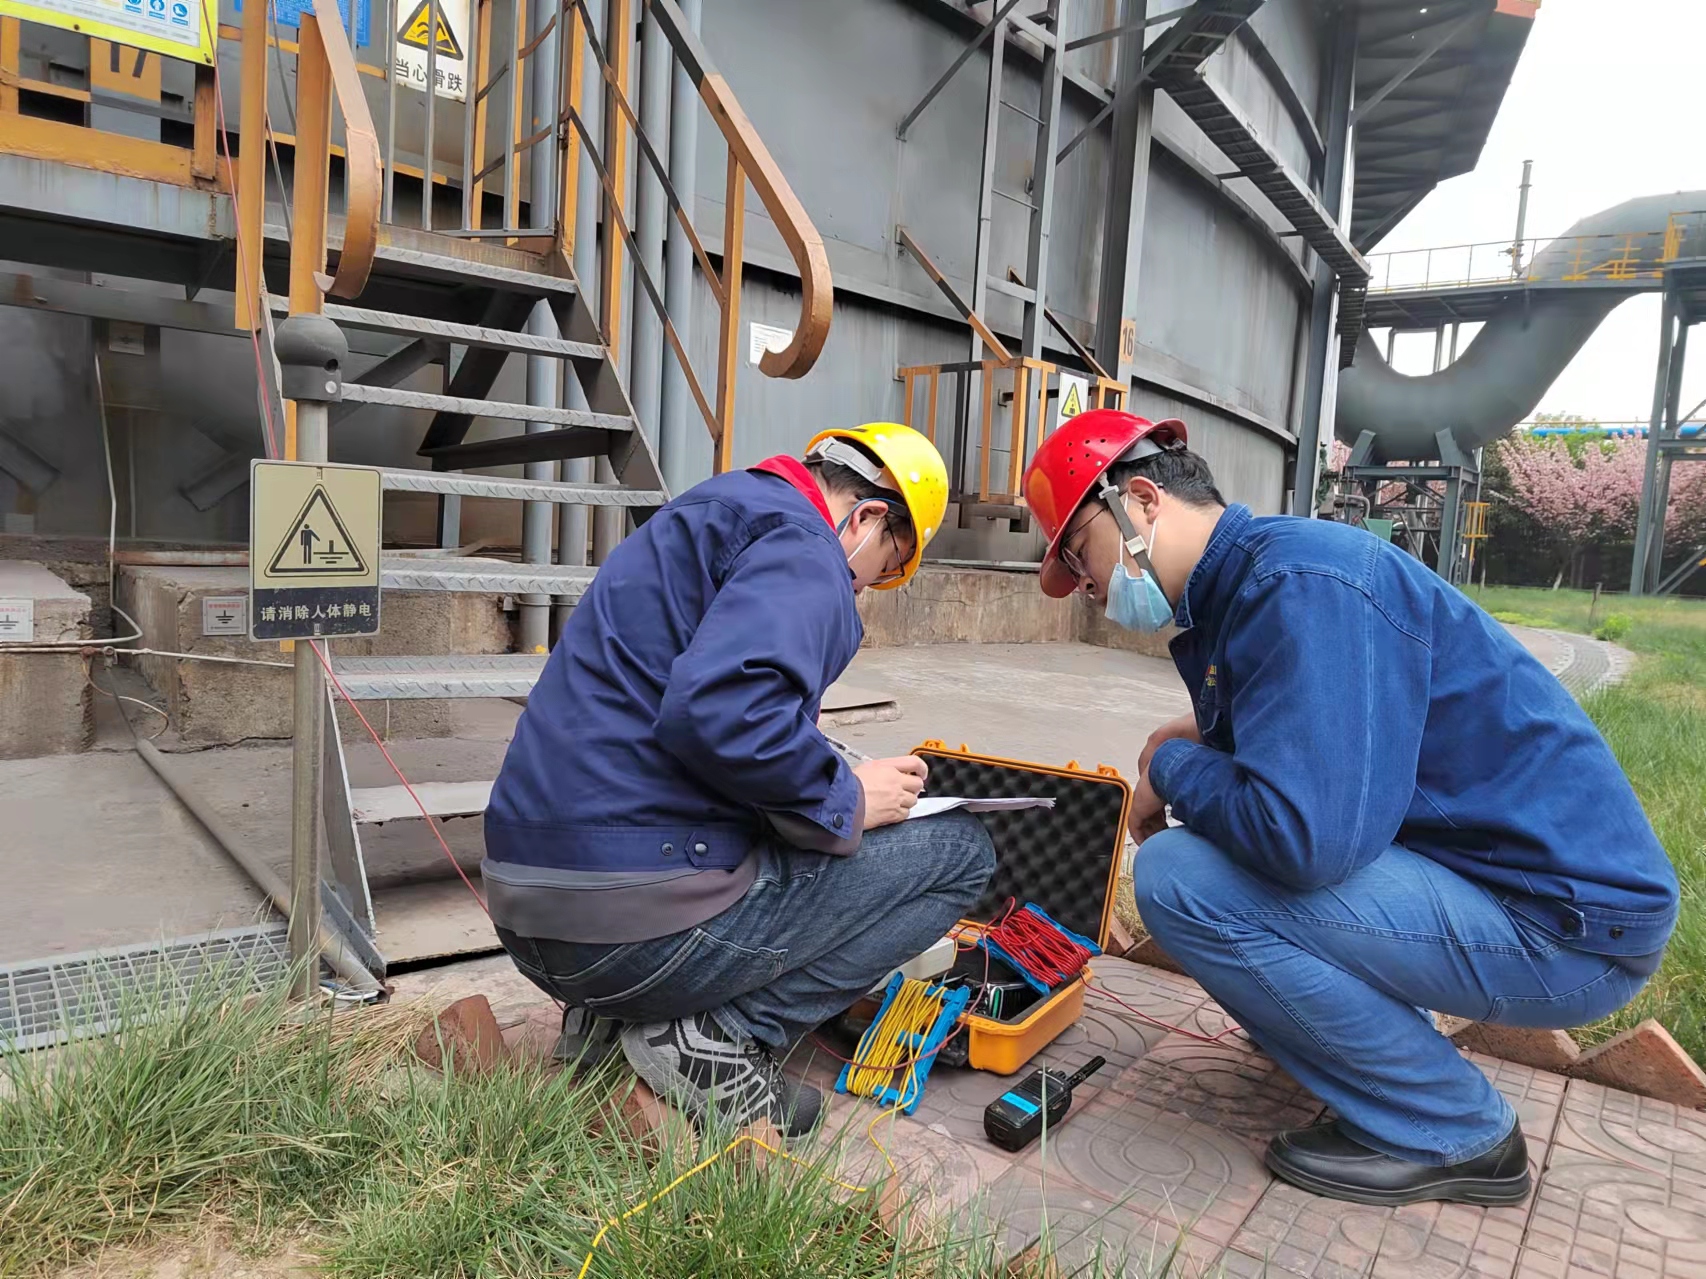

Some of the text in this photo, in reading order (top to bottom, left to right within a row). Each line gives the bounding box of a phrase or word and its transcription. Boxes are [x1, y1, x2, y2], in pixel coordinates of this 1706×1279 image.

[396, 59, 463, 93] 当心滑跌
[1123, 324, 1134, 357] 16
[261, 603, 372, 622] 请消除人体静电
